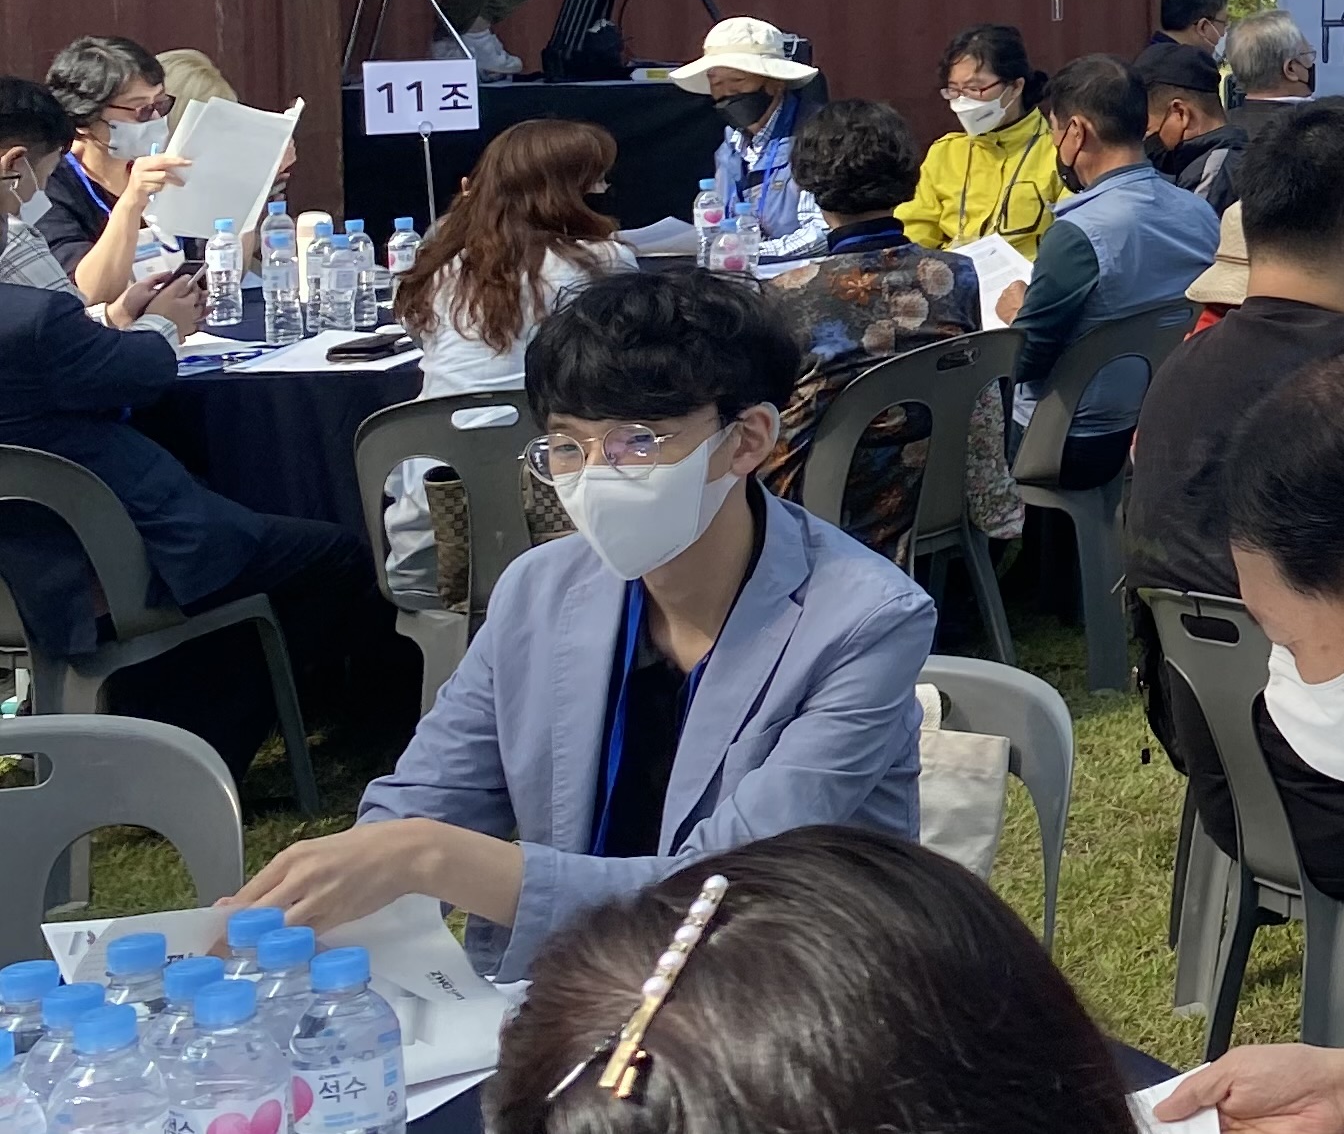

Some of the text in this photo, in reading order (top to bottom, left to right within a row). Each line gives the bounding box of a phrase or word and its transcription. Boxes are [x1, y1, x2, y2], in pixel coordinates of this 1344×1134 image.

[376, 81, 473, 114] 11 조
[319, 1075, 368, 1103] 석수
